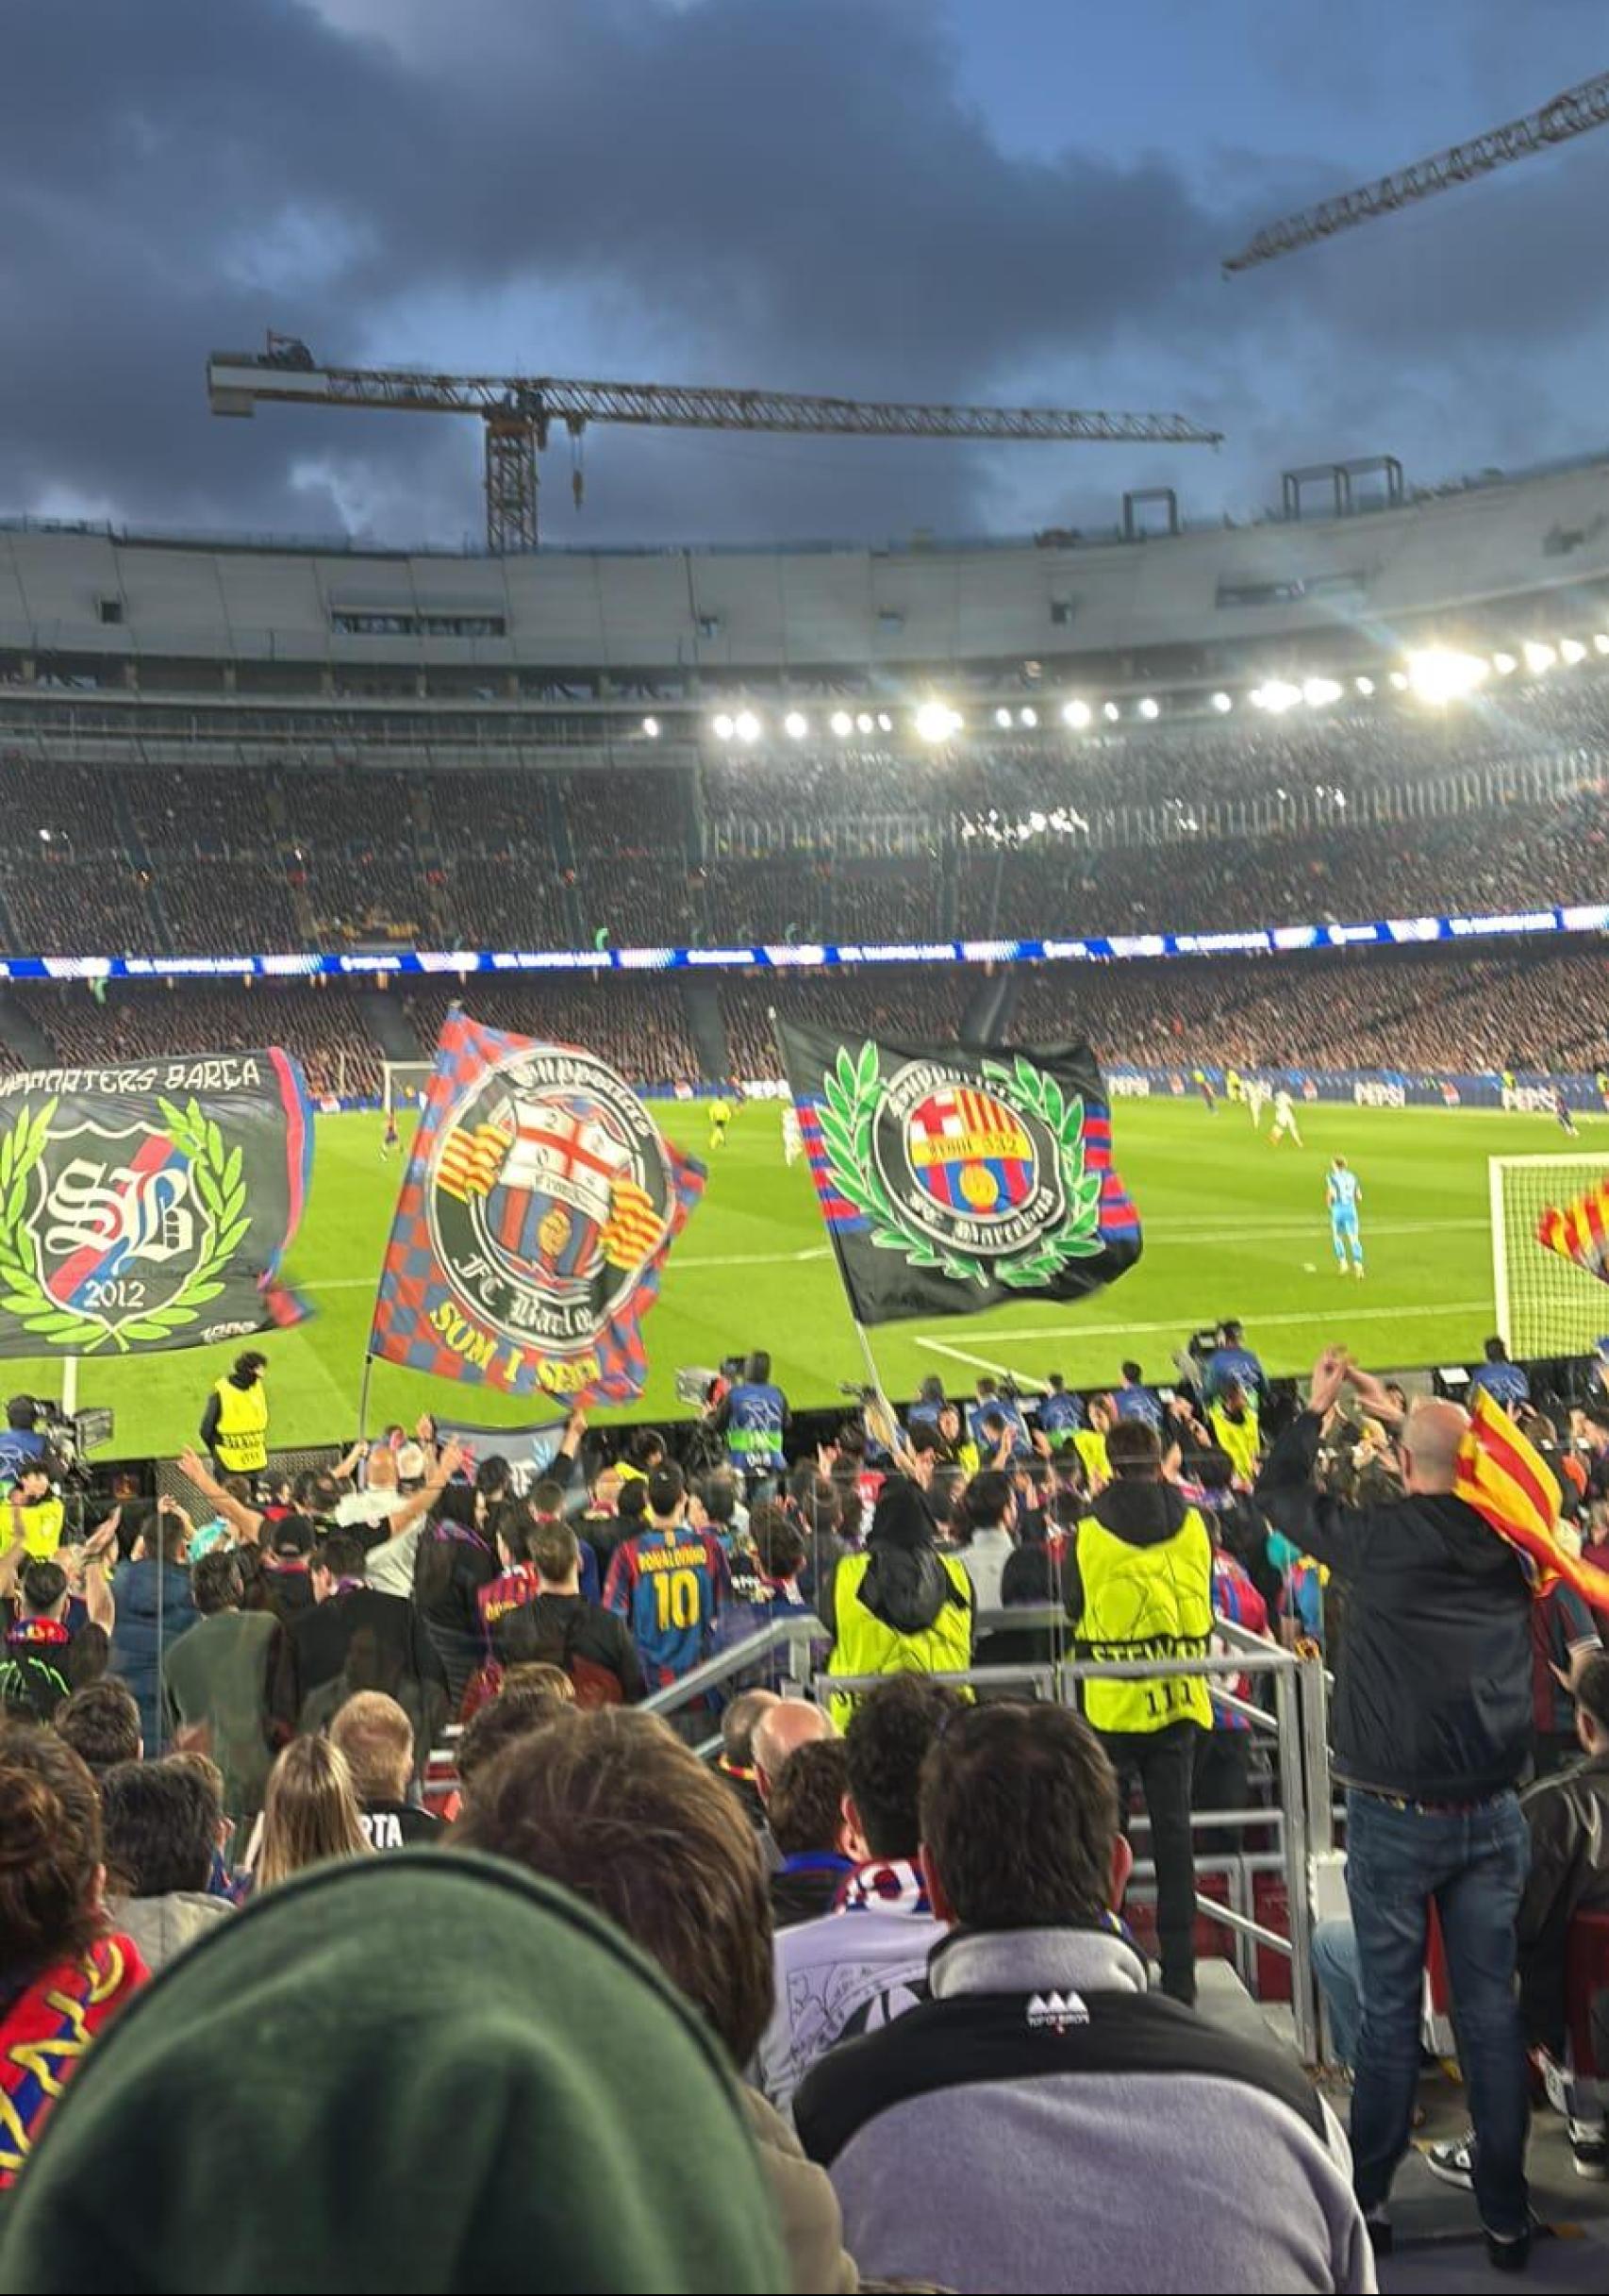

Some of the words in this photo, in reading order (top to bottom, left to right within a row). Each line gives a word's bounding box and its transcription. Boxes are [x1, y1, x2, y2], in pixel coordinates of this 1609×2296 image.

[164, 1058, 260, 1090] BARÇA
[84, 1279, 146, 1307] 2012
[503, 1347, 524, 1383] I
[653, 1569, 700, 1633] 10
